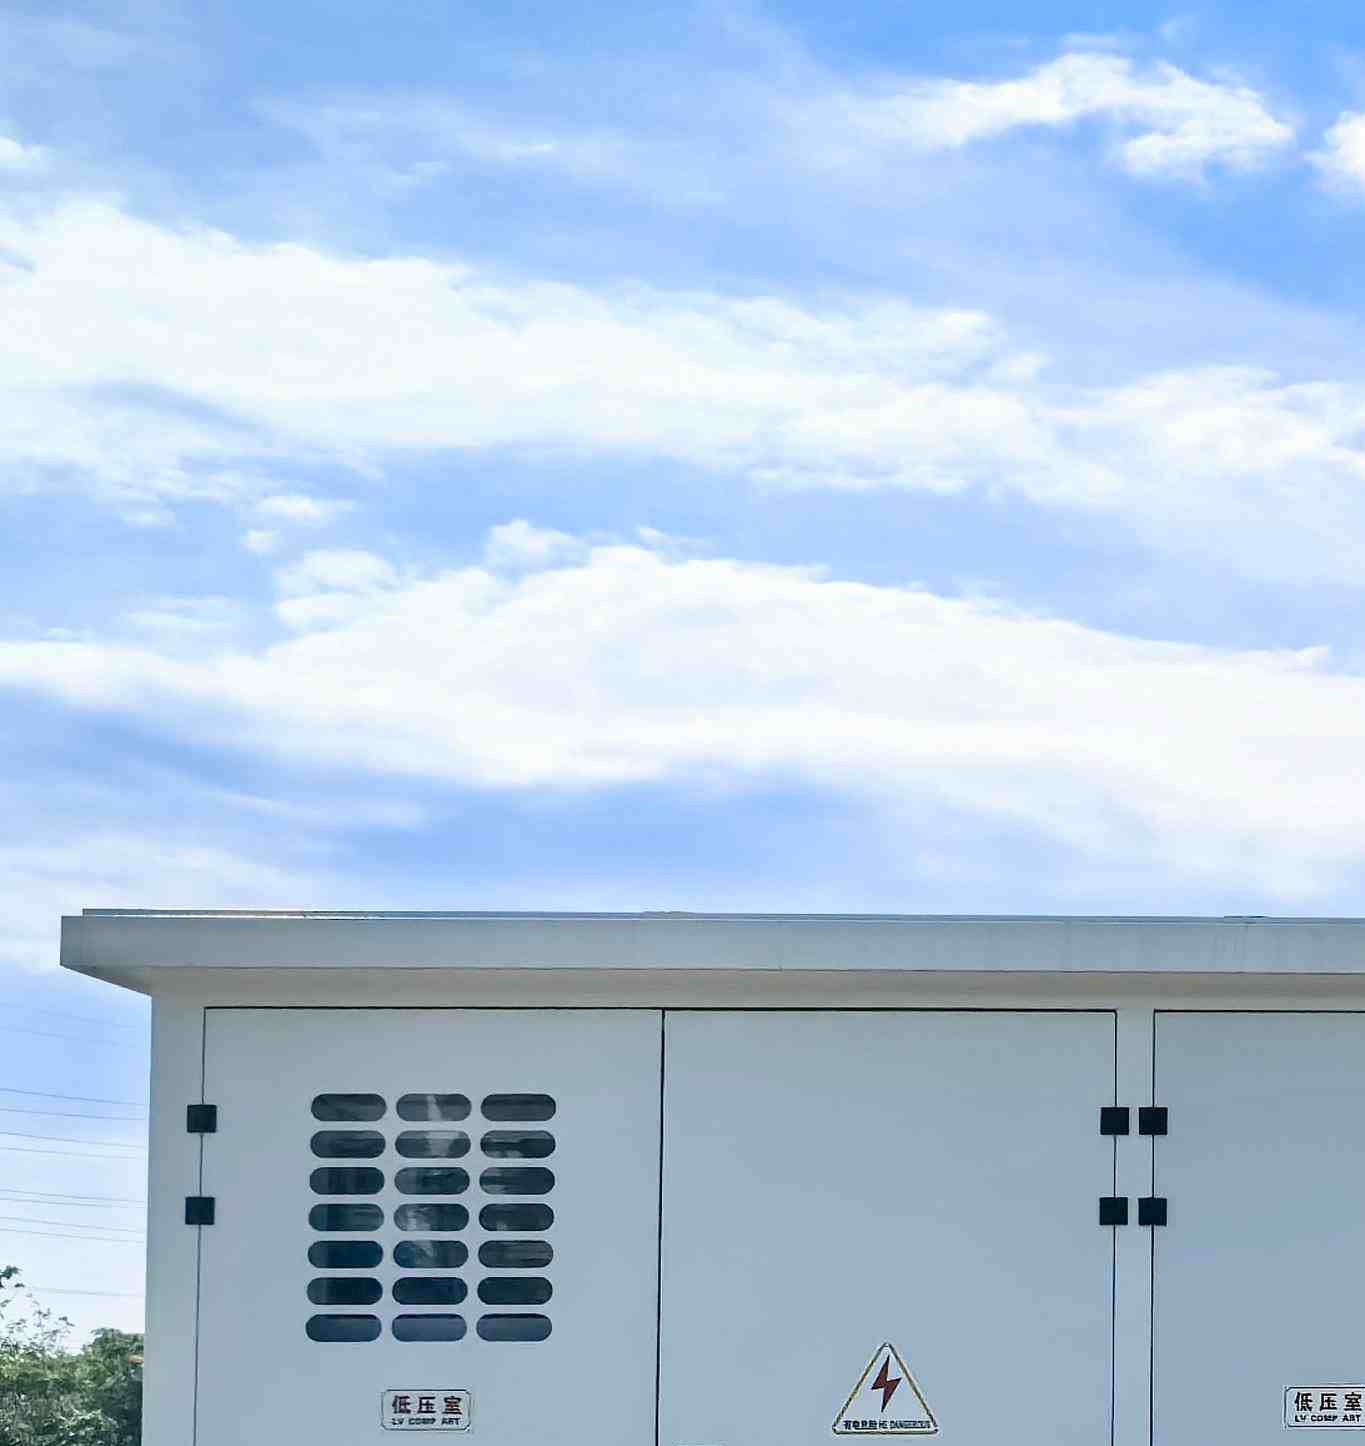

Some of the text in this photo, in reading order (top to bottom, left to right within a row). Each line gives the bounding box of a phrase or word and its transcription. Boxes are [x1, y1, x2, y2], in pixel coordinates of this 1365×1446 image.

[392, 1395, 462, 1414] 低压室
[1295, 1391, 1362, 1411] 低压室
[1294, 1414, 1307, 1422] LV
[1310, 1414, 1338, 1422] COMP
